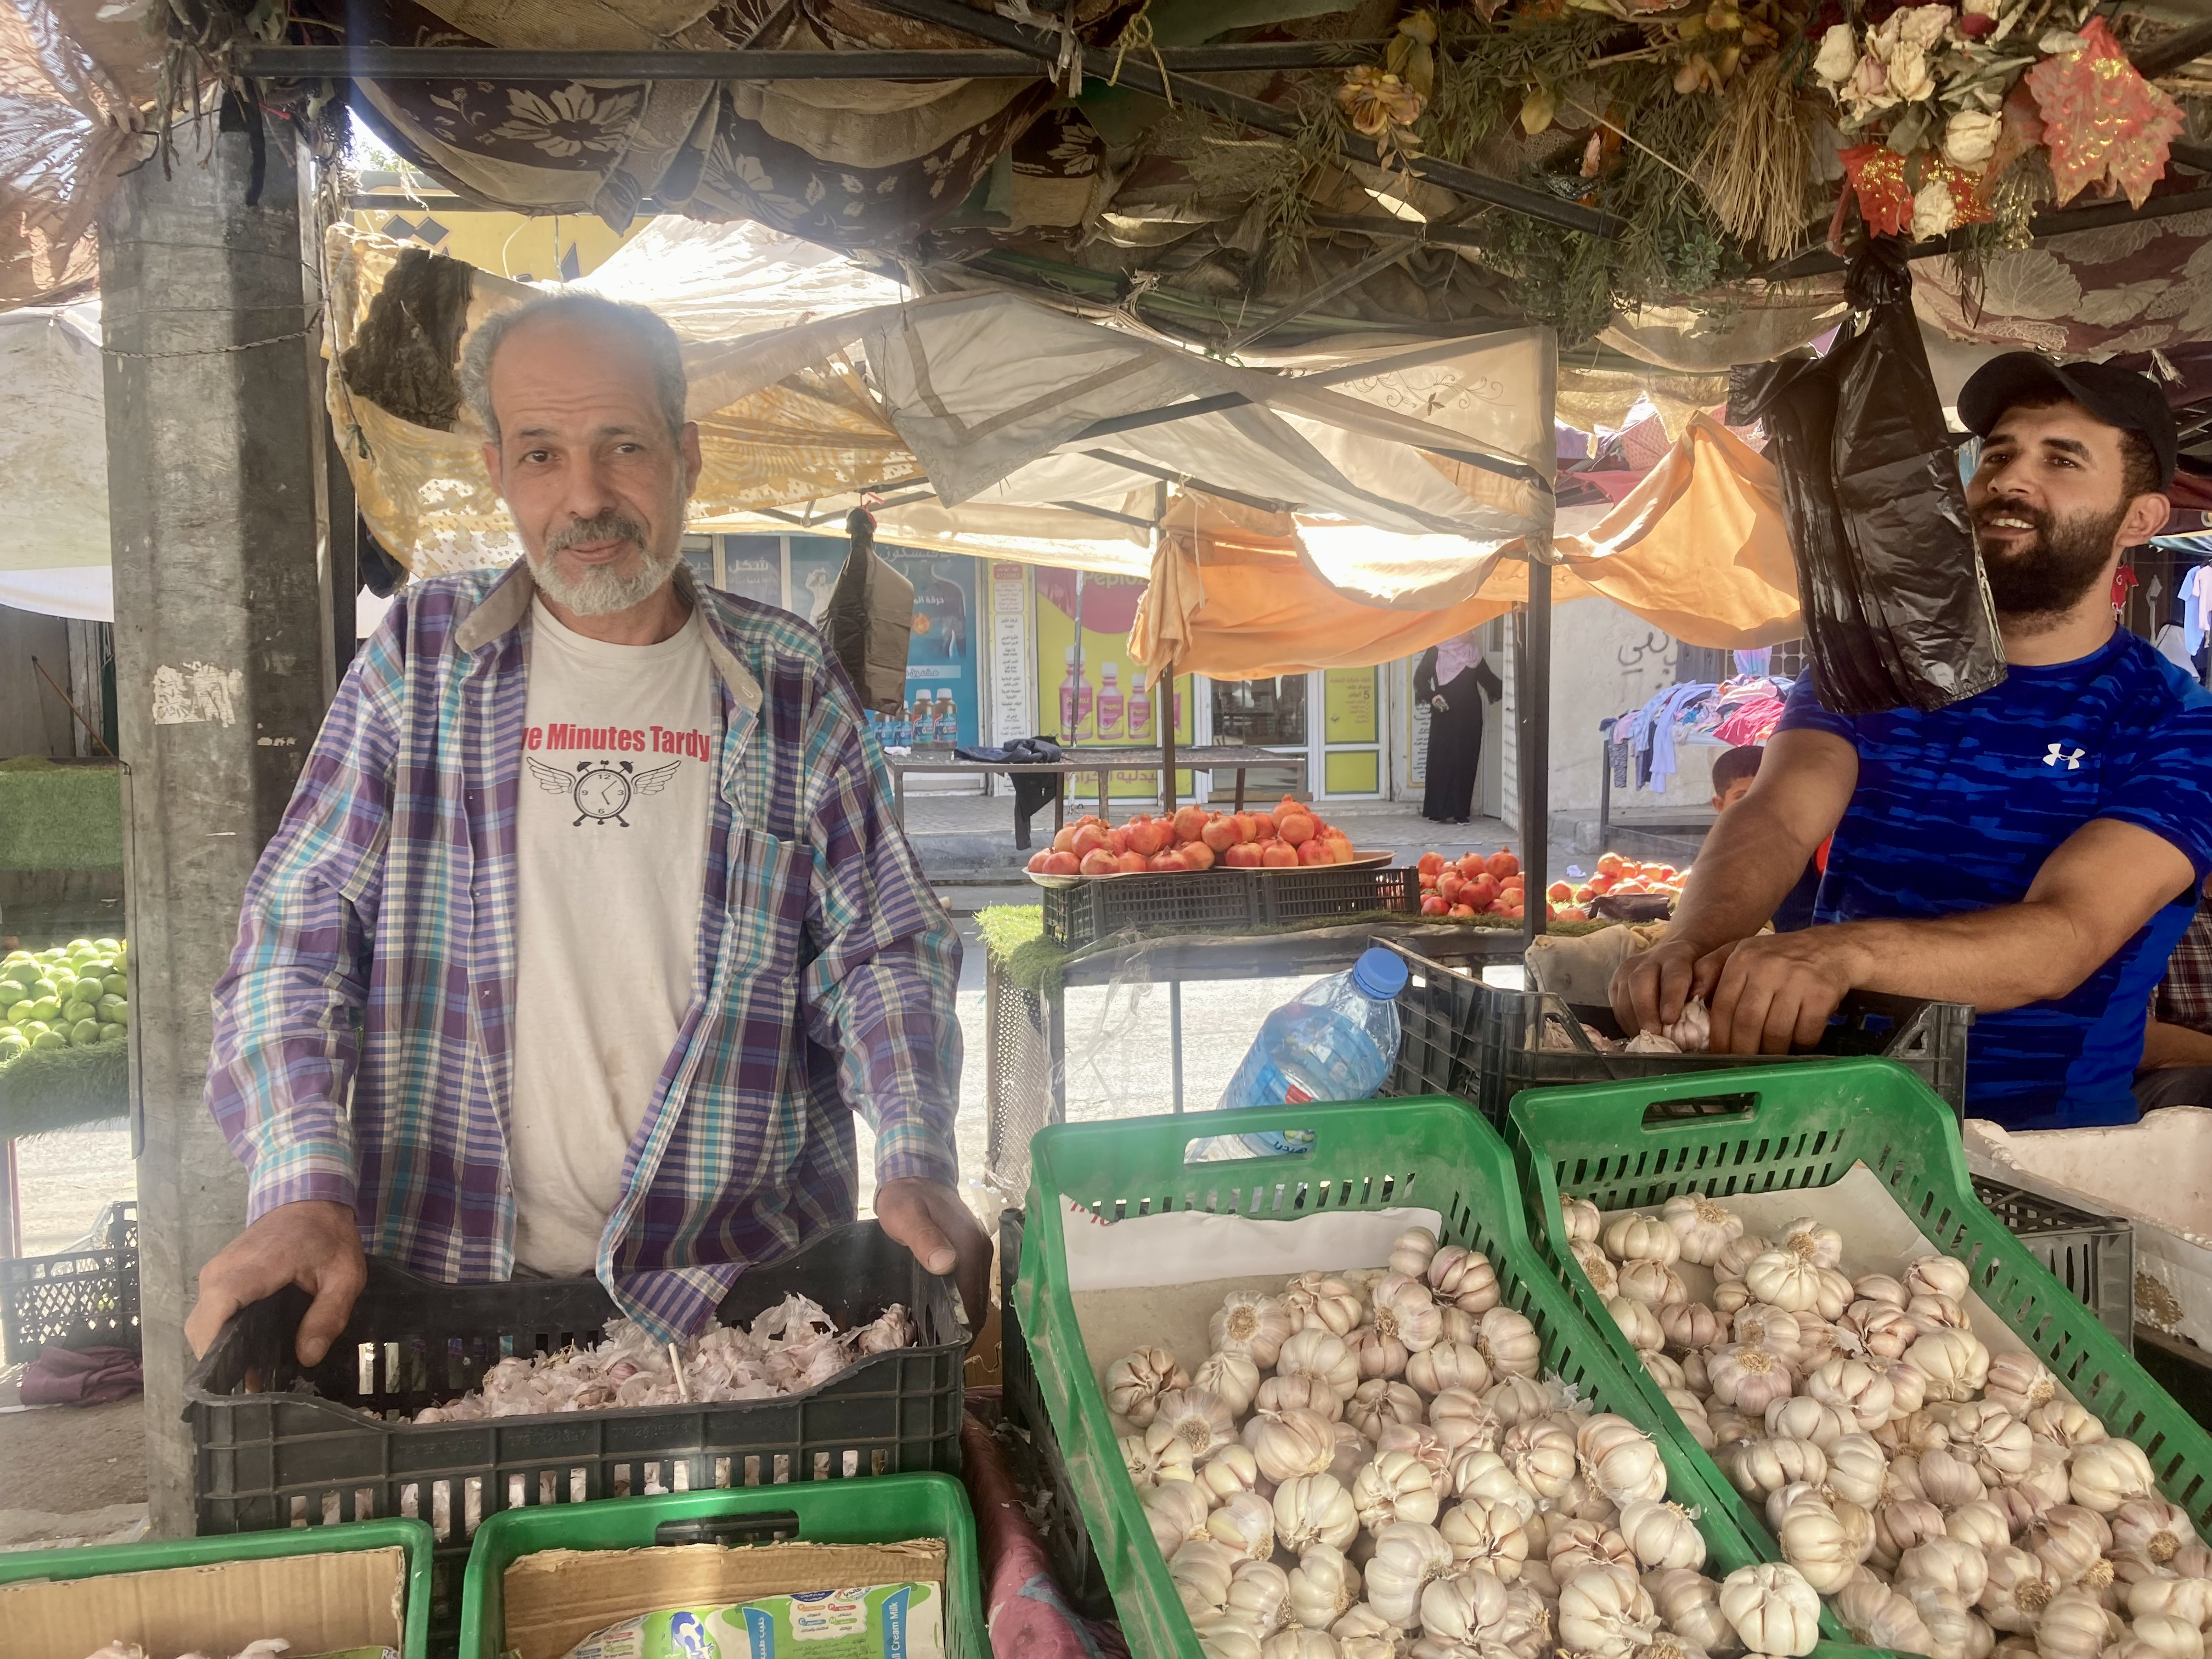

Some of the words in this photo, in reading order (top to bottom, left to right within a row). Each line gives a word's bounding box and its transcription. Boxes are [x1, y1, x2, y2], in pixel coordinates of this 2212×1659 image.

[728, 556, 769, 573] شكل
[926, 596, 944, 605] حرقة
[1363, 690, 1370, 699] 5
[521, 726, 543, 751] ve
[546, 723, 646, 752] Minutes
[650, 725, 710, 763] Tardy
[888, 1601, 899, 1620] Milk
[891, 1621, 901, 1651] Cream
